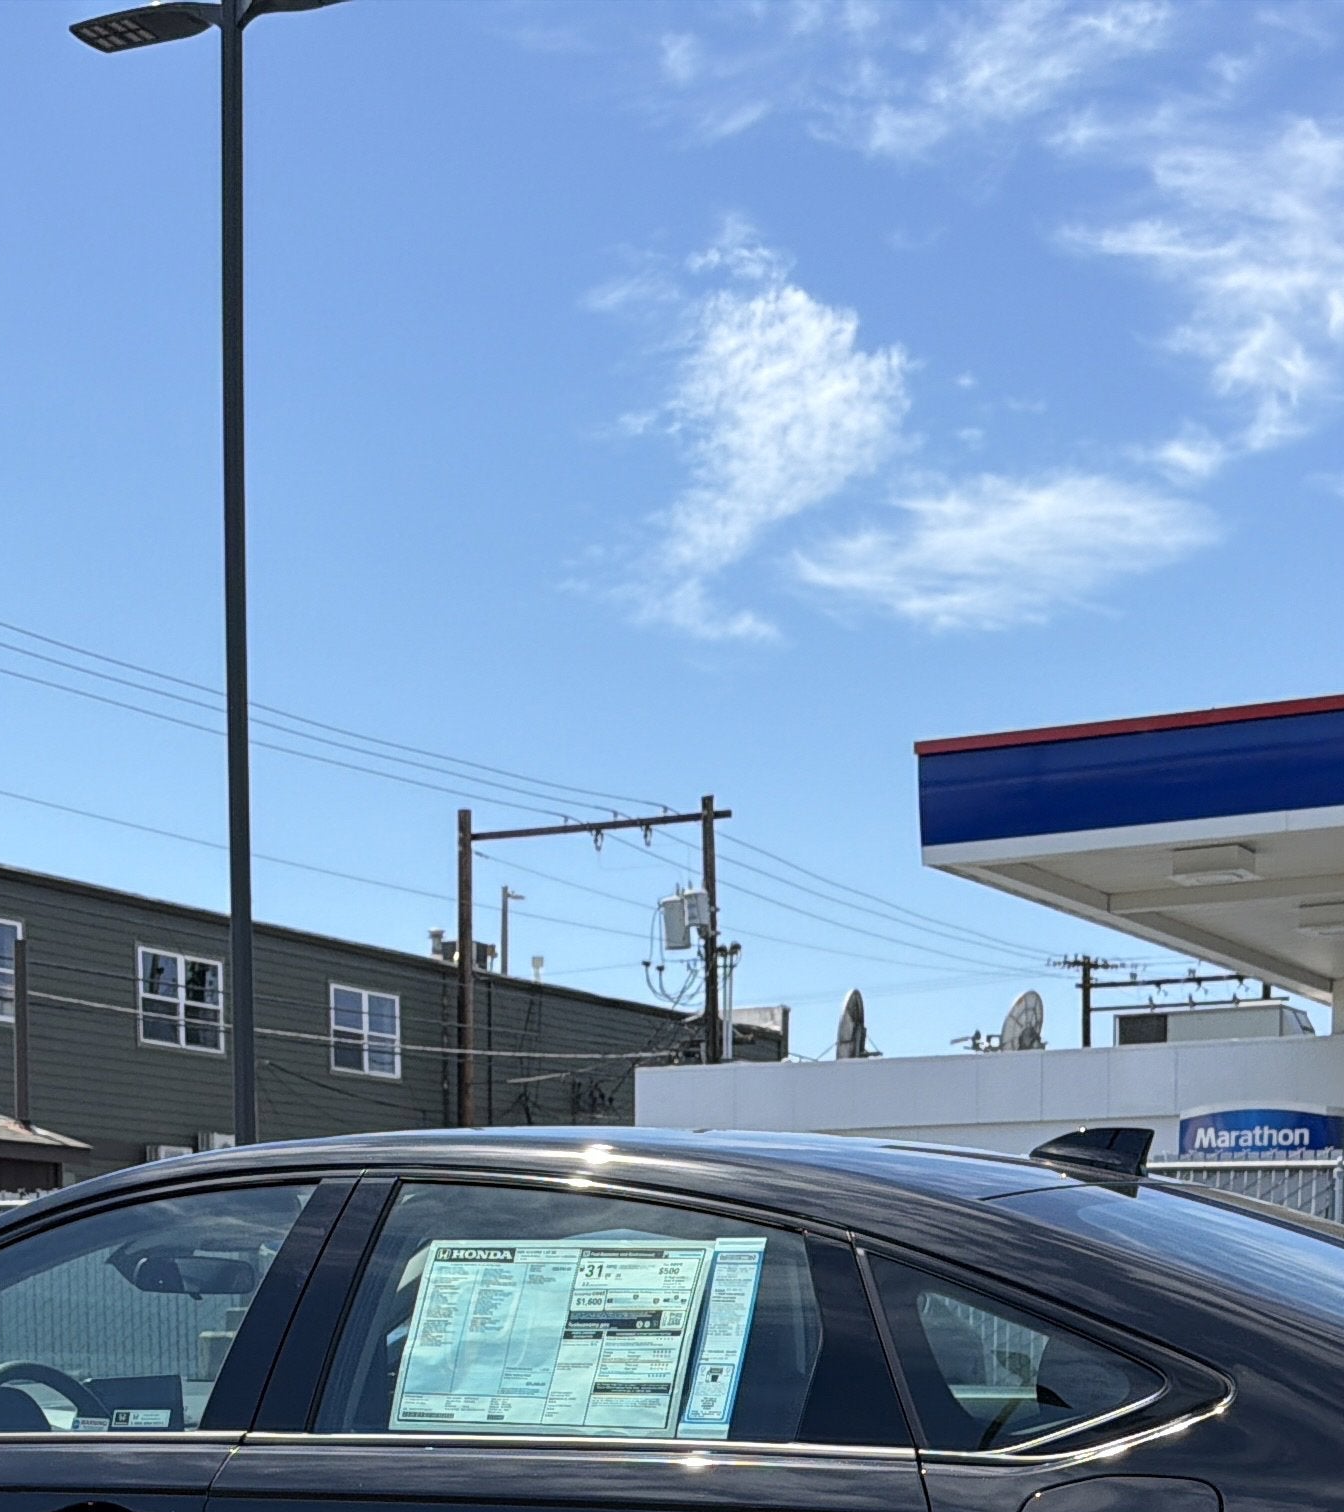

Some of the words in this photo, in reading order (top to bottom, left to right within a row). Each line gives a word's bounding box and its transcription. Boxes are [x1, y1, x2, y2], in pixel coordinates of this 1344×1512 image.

[1194, 1125, 1310, 1149] Marathon
[451, 1249, 513, 1260] HONDA
[585, 1264, 604, 1278] 31
[658, 1267, 680, 1275] $500
[576, 1298, 603, 1306] $1,600
